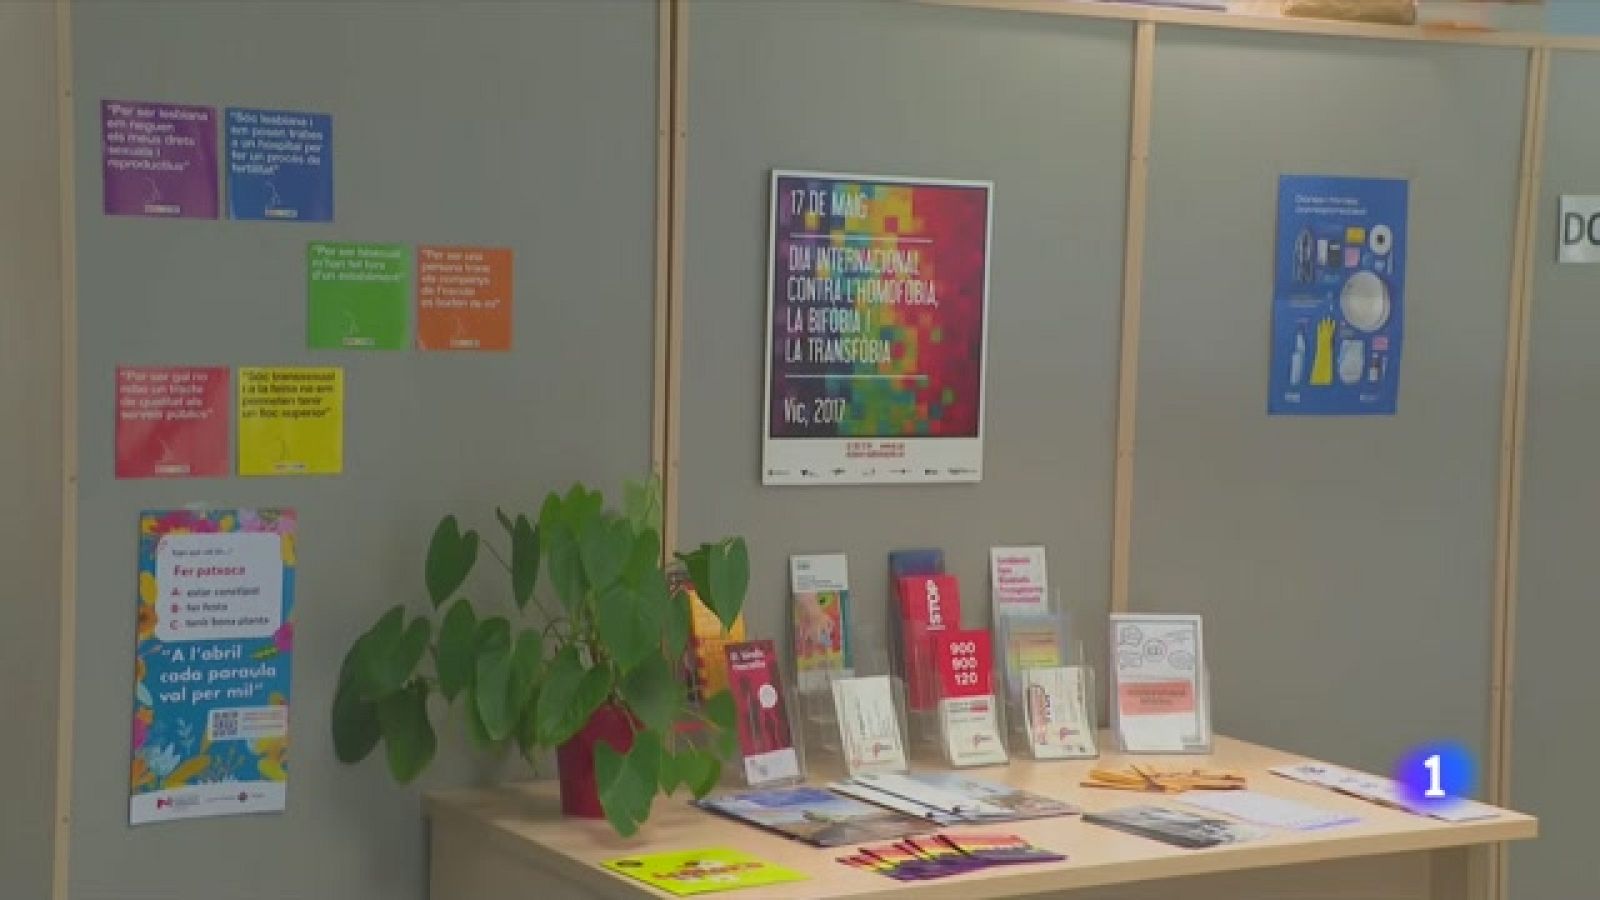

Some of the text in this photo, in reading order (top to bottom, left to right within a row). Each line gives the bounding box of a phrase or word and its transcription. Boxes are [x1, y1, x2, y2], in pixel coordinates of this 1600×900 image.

[791, 188, 806, 215] 17
[809, 189, 827, 216] DE
[789, 244, 920, 275] DIA INTERNACIONAL
[786, 275, 842, 303] CONTRA
[786, 306, 803, 334] LA
[784, 338, 803, 363] LA
[814, 397, 847, 424] 2017
[174, 565, 193, 576] Fer
[949, 640, 976, 656] 900
[159, 662, 276, 684] cada paraula
[954, 672, 978, 686] 120
[159, 686, 186, 703] val
[192, 687, 221, 706] per
